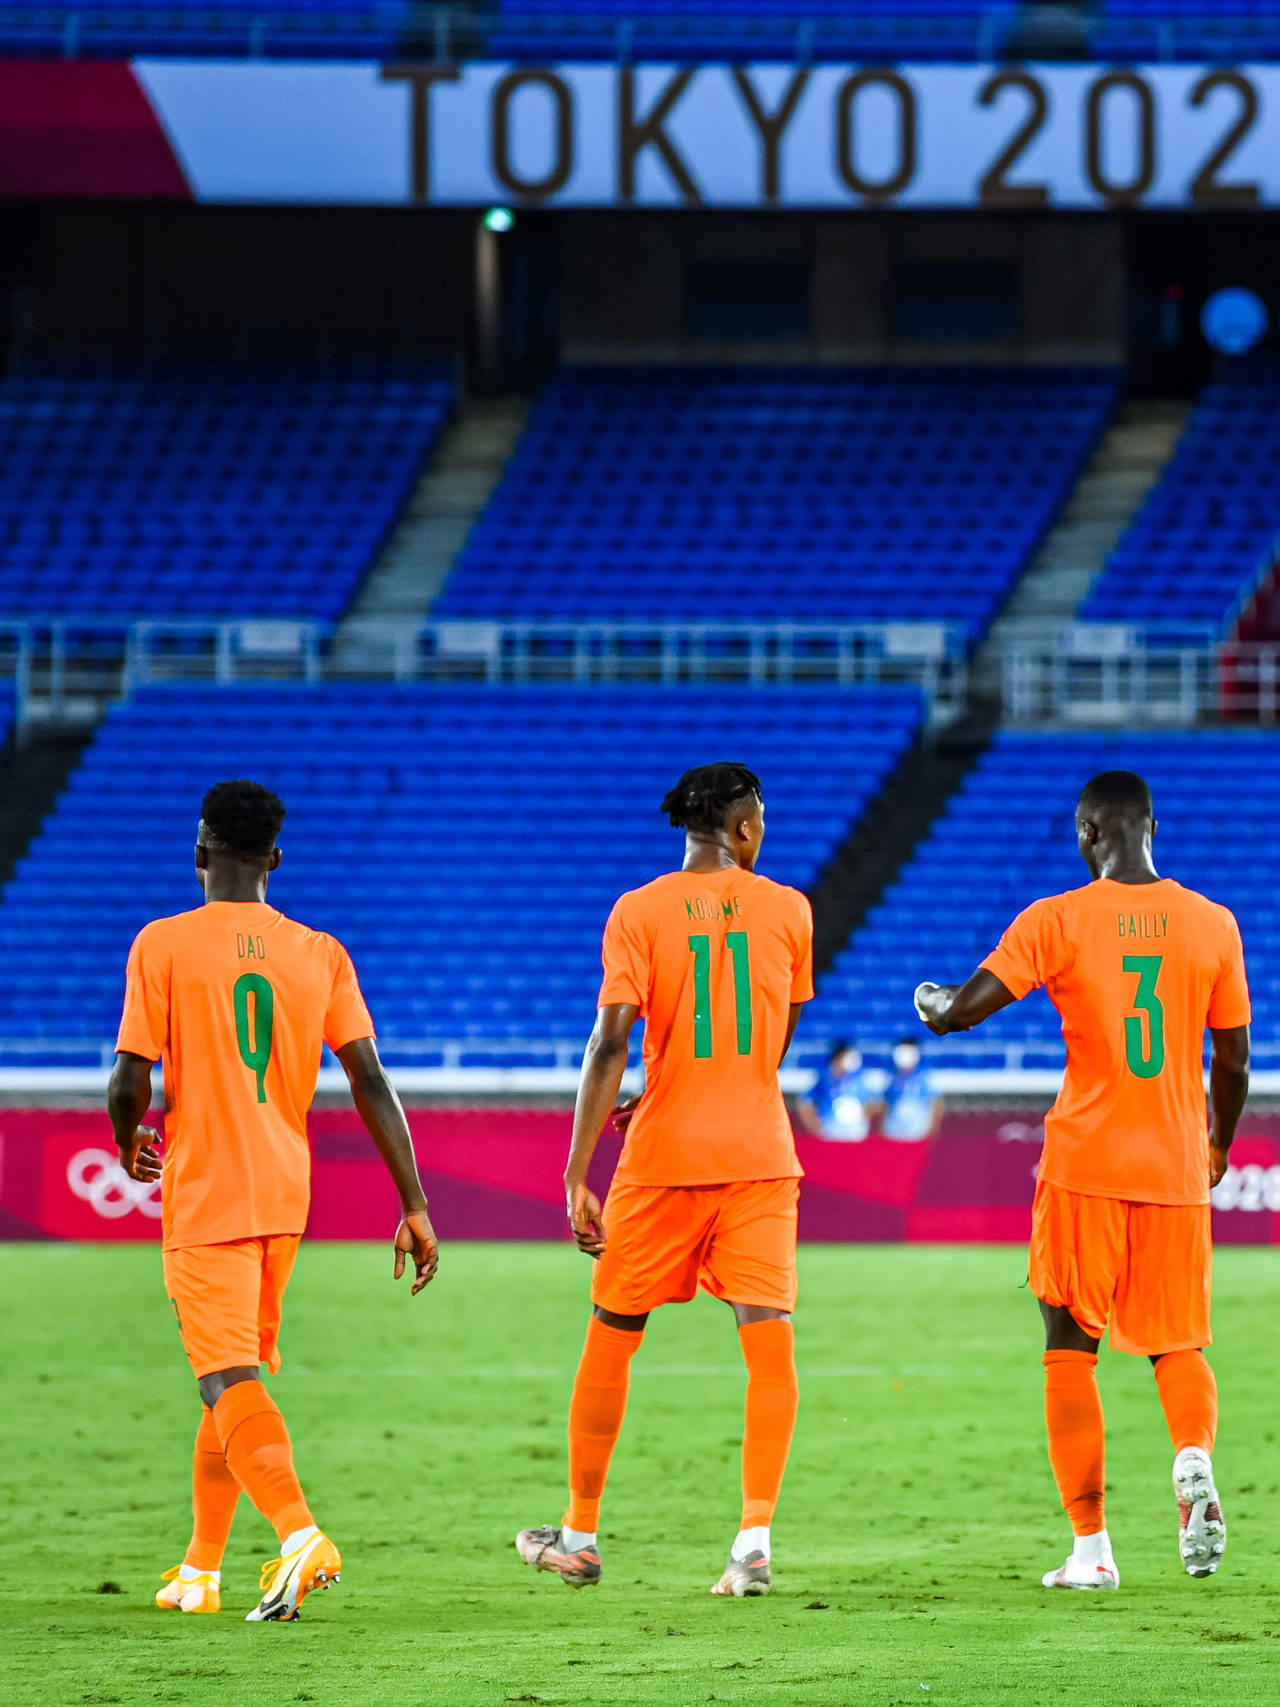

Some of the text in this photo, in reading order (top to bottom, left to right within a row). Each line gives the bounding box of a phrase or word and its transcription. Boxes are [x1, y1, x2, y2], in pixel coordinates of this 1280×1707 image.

[379, 64, 917, 206] TOKYO
[1118, 913, 1168, 938] BAILLY
[233, 973, 274, 1104] 9
[688, 931, 752, 1058] 11
[1122, 956, 1165, 1079] 3
